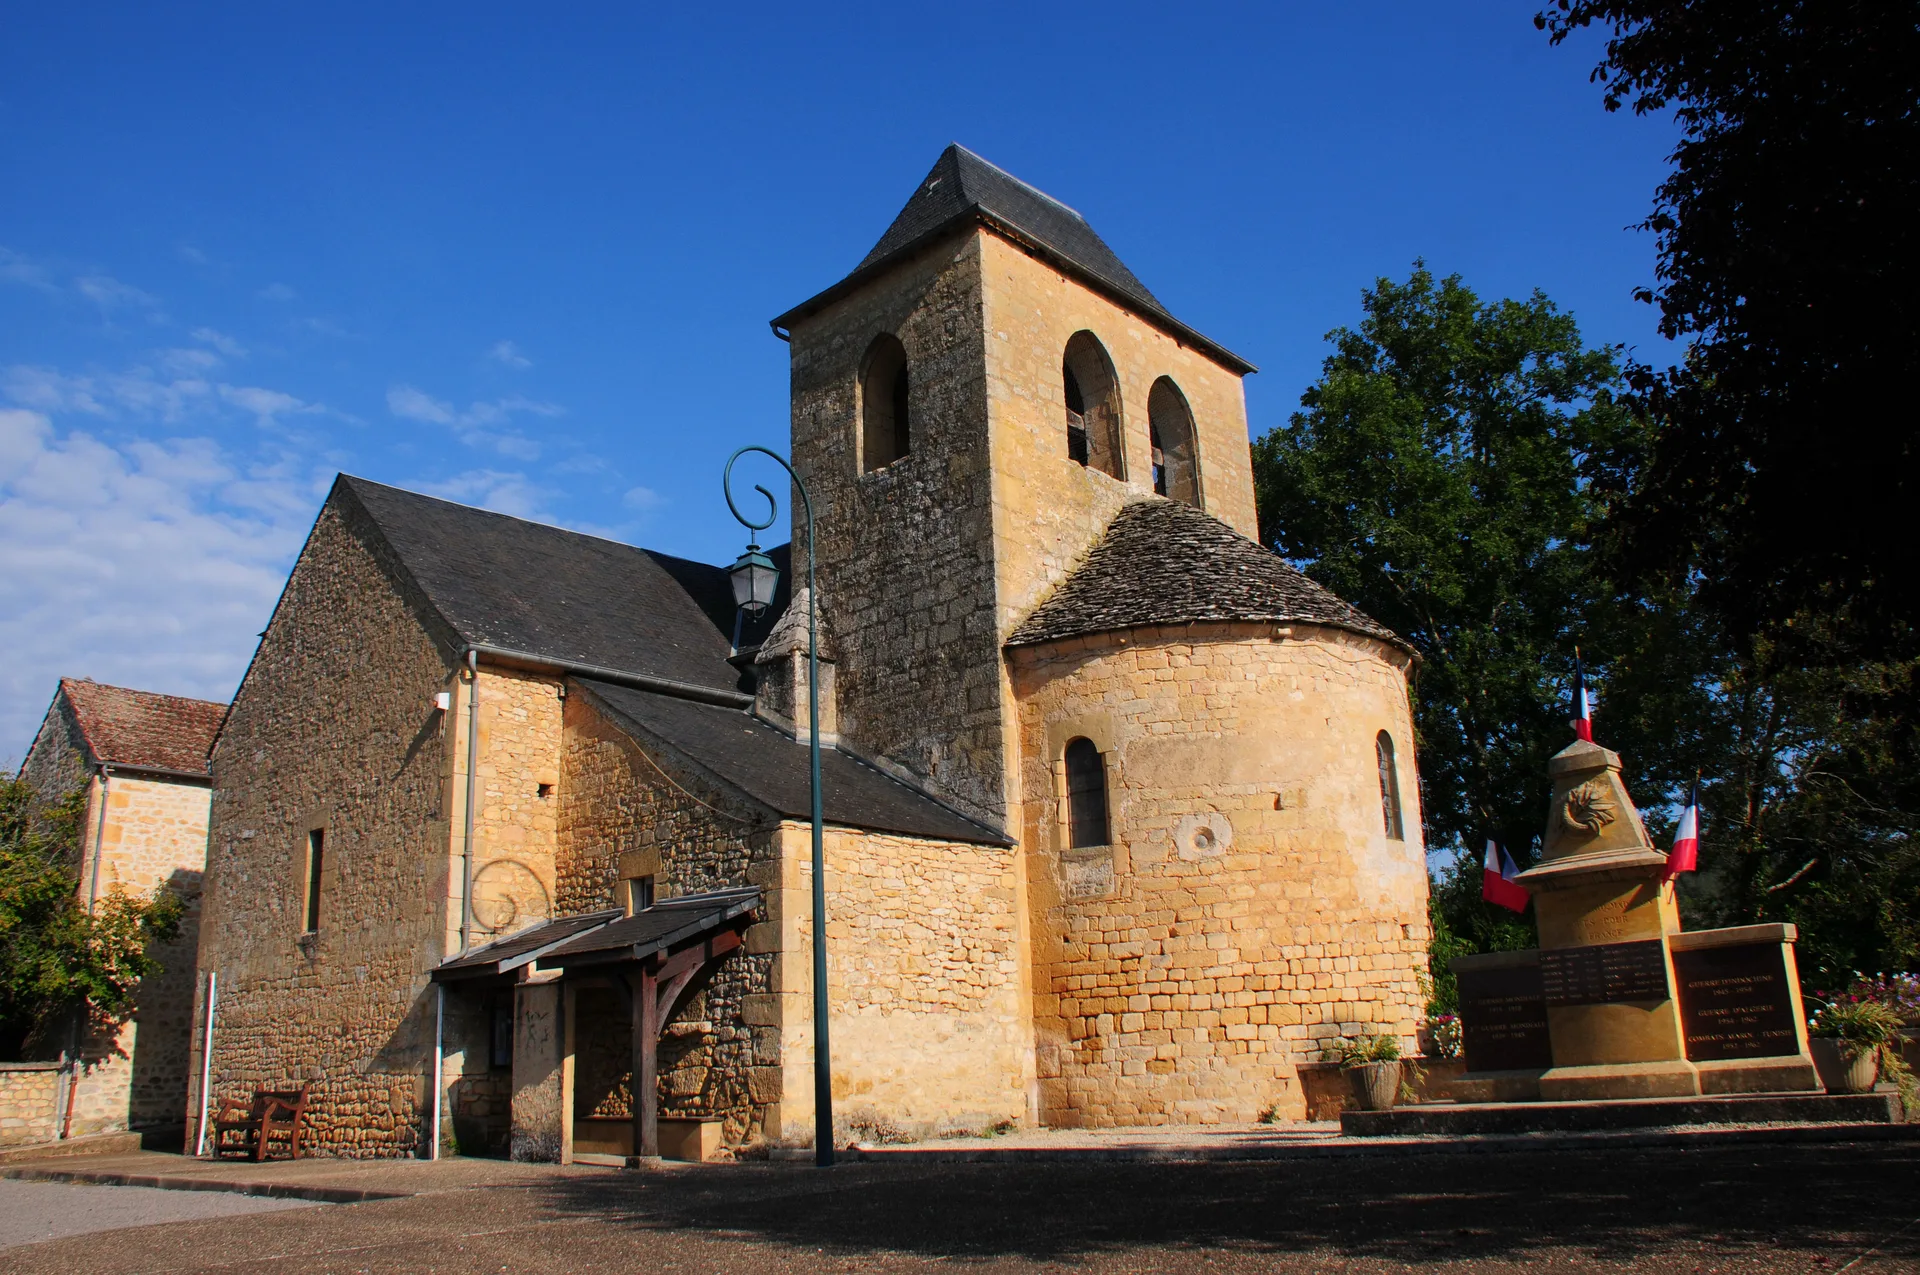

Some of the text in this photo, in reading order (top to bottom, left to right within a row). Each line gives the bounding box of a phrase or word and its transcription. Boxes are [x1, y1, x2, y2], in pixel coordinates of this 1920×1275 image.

[1588, 928, 1624, 940] FRANCE
[1688, 980, 1720, 989] GUERRE
[1698, 1008, 1730, 1017] GUERRE
